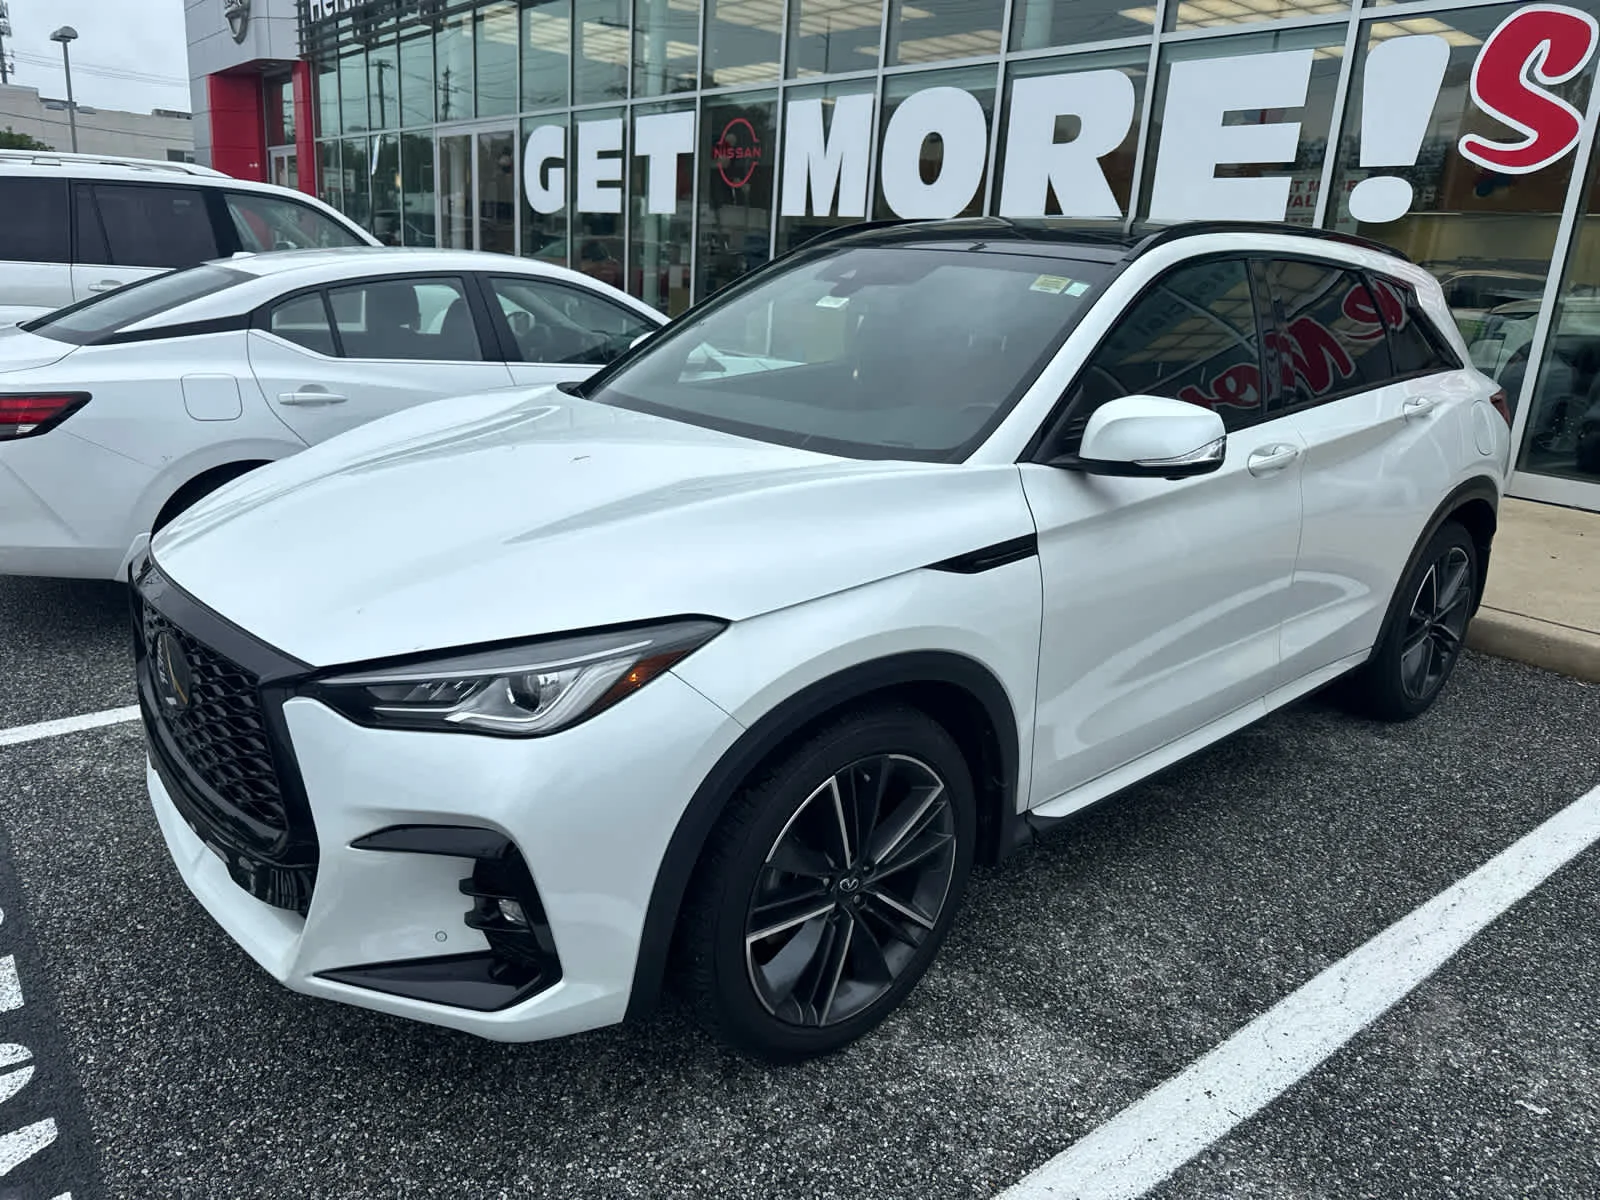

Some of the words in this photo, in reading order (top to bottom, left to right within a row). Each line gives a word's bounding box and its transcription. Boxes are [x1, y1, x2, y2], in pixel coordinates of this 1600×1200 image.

[524, 111, 696, 215] GET
[781, 34, 1450, 224] MORE!
[712, 146, 762, 159] NISSAN
